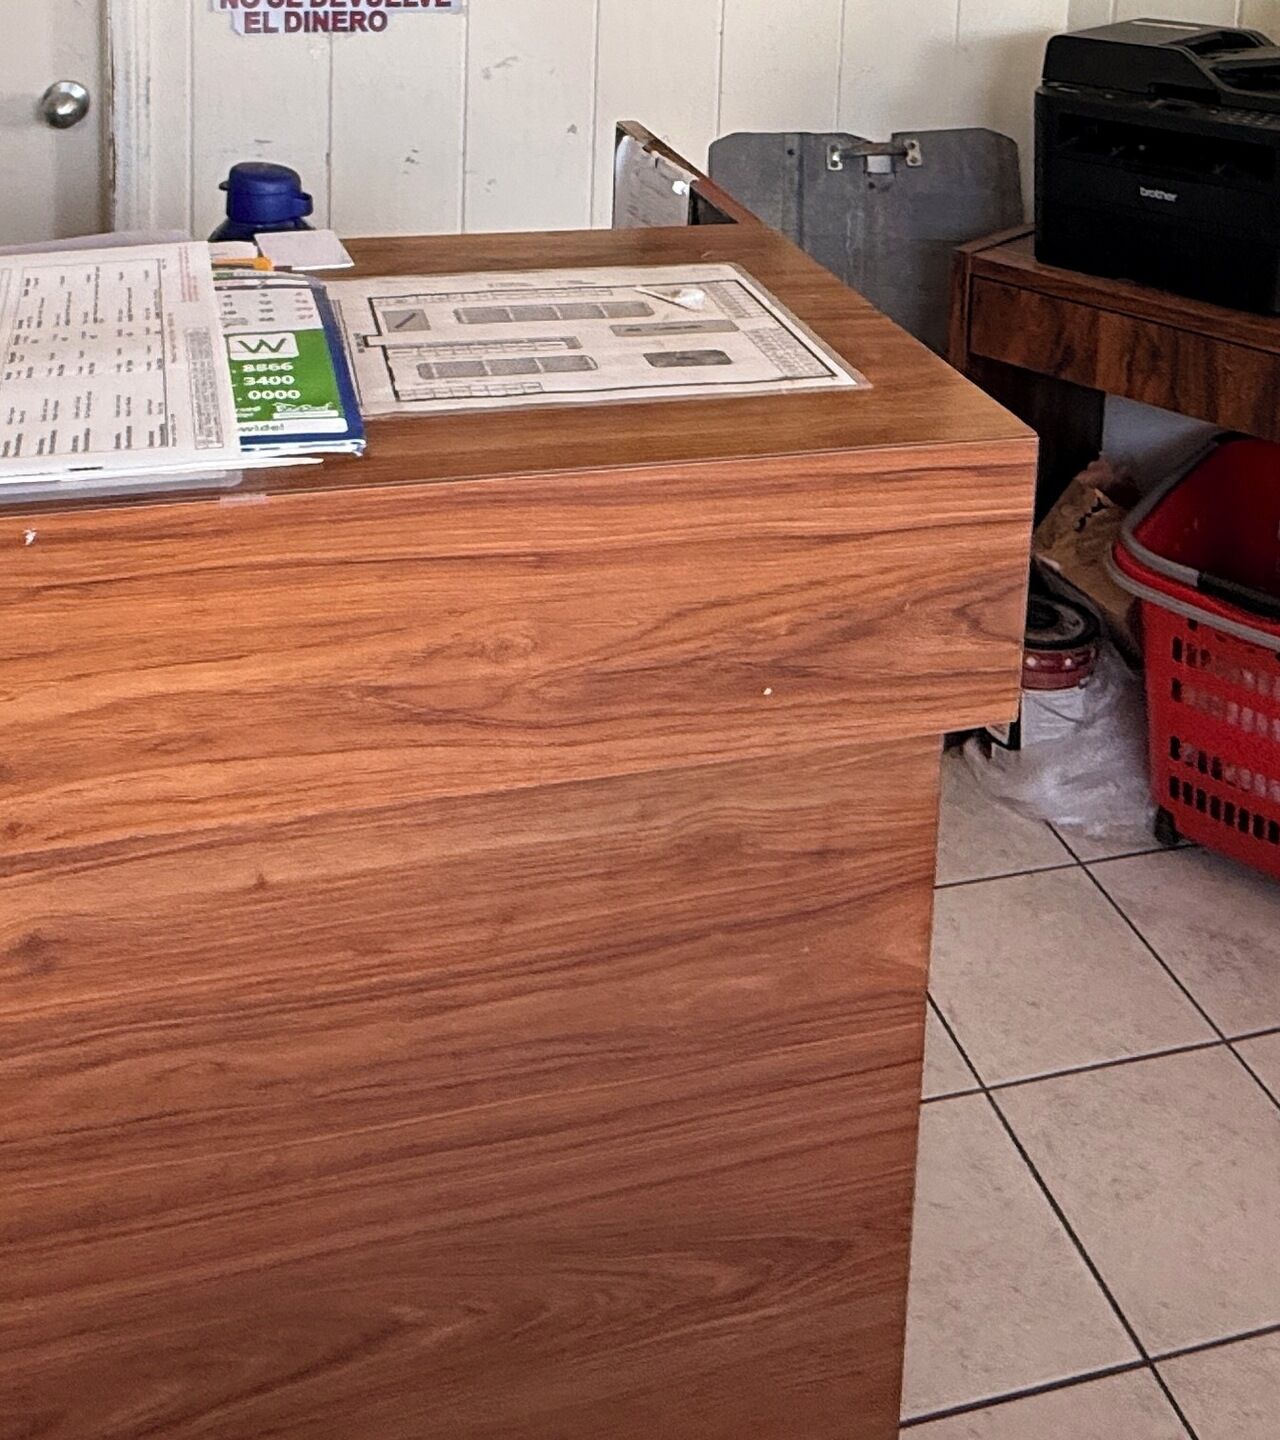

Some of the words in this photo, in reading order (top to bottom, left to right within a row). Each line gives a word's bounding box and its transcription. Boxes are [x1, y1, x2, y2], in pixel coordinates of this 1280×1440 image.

[244, 11, 279, 34] EL
[284, 10, 388, 34] DINERO
[1140, 186, 1178, 202] brother
[243, 375, 296, 386] 3400
[247, 389, 301, 400] 0000
